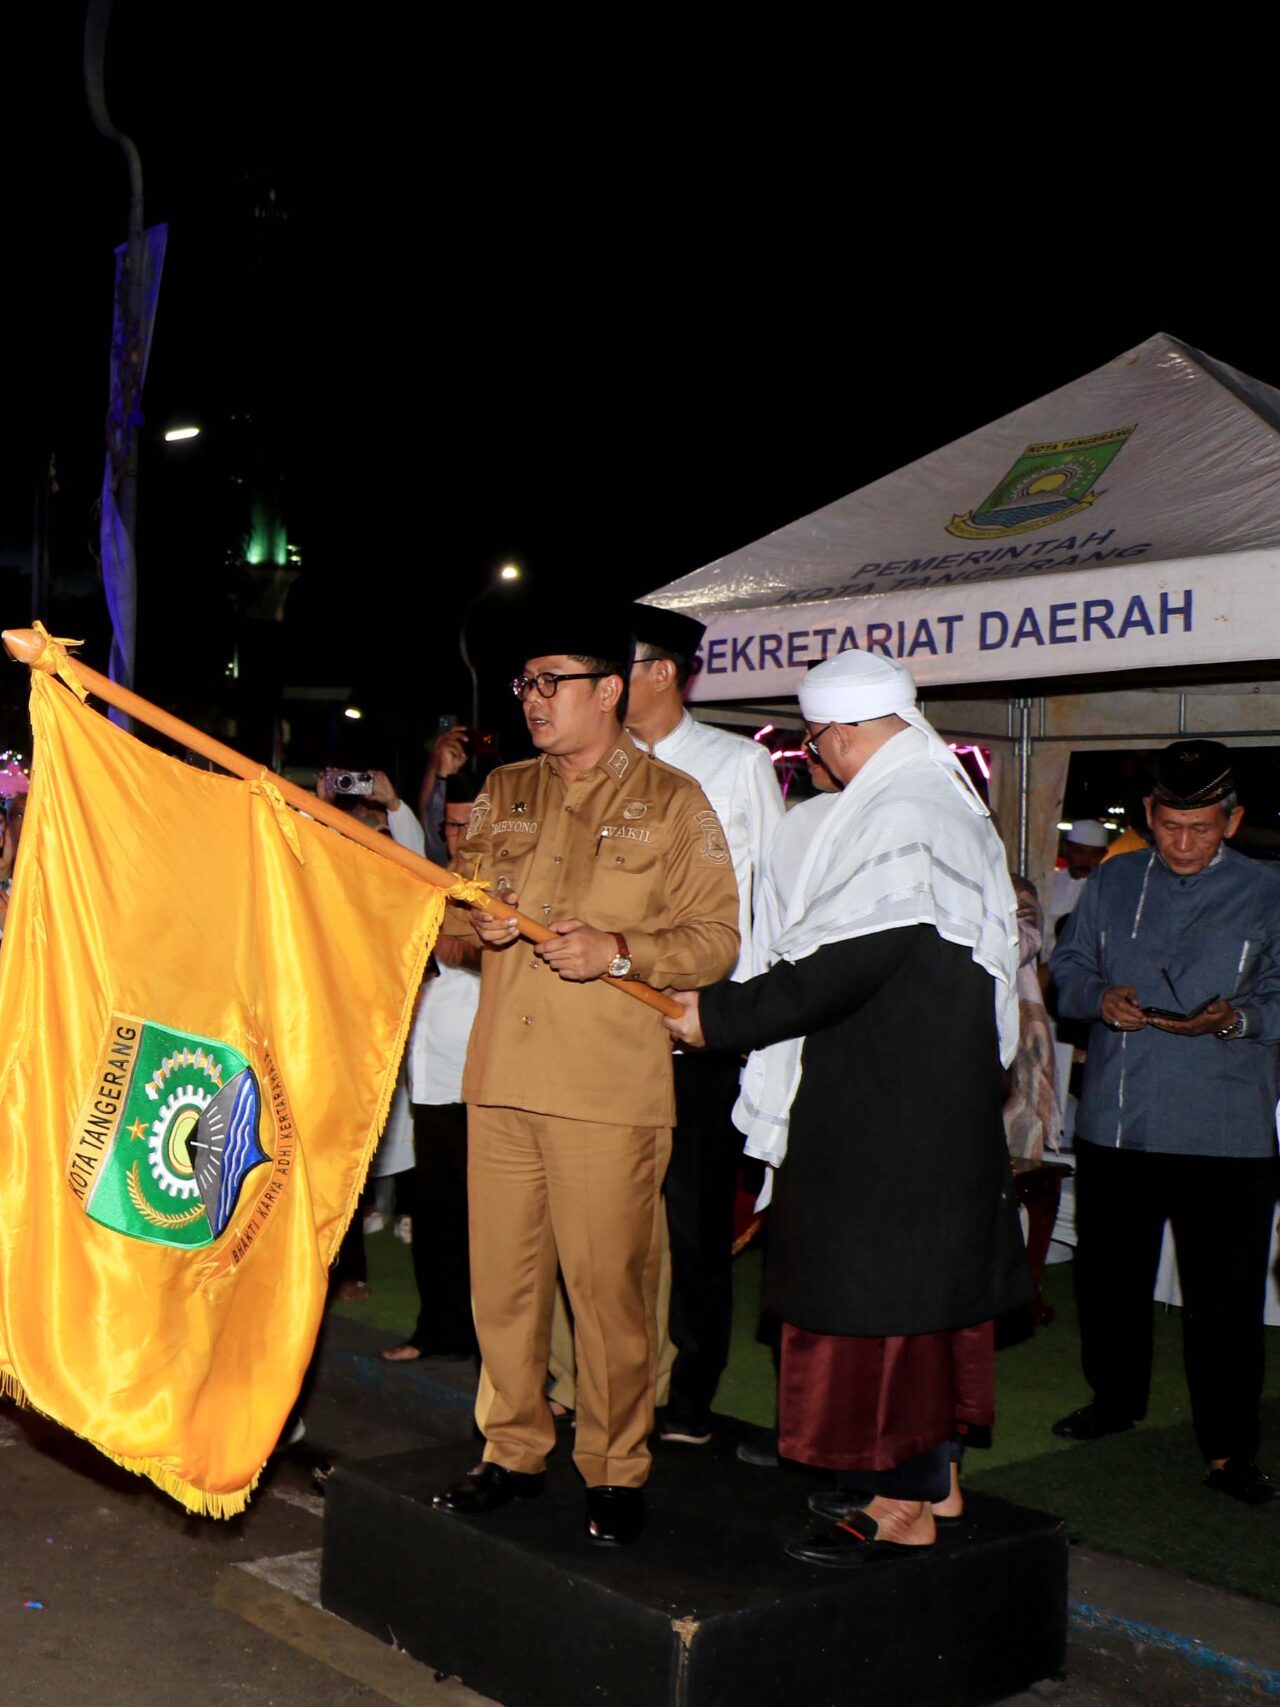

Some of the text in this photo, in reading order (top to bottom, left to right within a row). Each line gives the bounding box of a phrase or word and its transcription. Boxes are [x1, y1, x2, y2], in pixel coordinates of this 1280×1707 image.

[776, 542, 1154, 602] KOTA TANGERANG
[852, 529, 1116, 579] PEMERINTAH
[979, 589, 1193, 651] DAERAH
[68, 1026, 136, 1200] KOTA TANGERANG
[232, 1222, 261, 1264] BHAKTI
[257, 1182, 284, 1218] KARYA
[278, 1144, 293, 1174] ADHI
